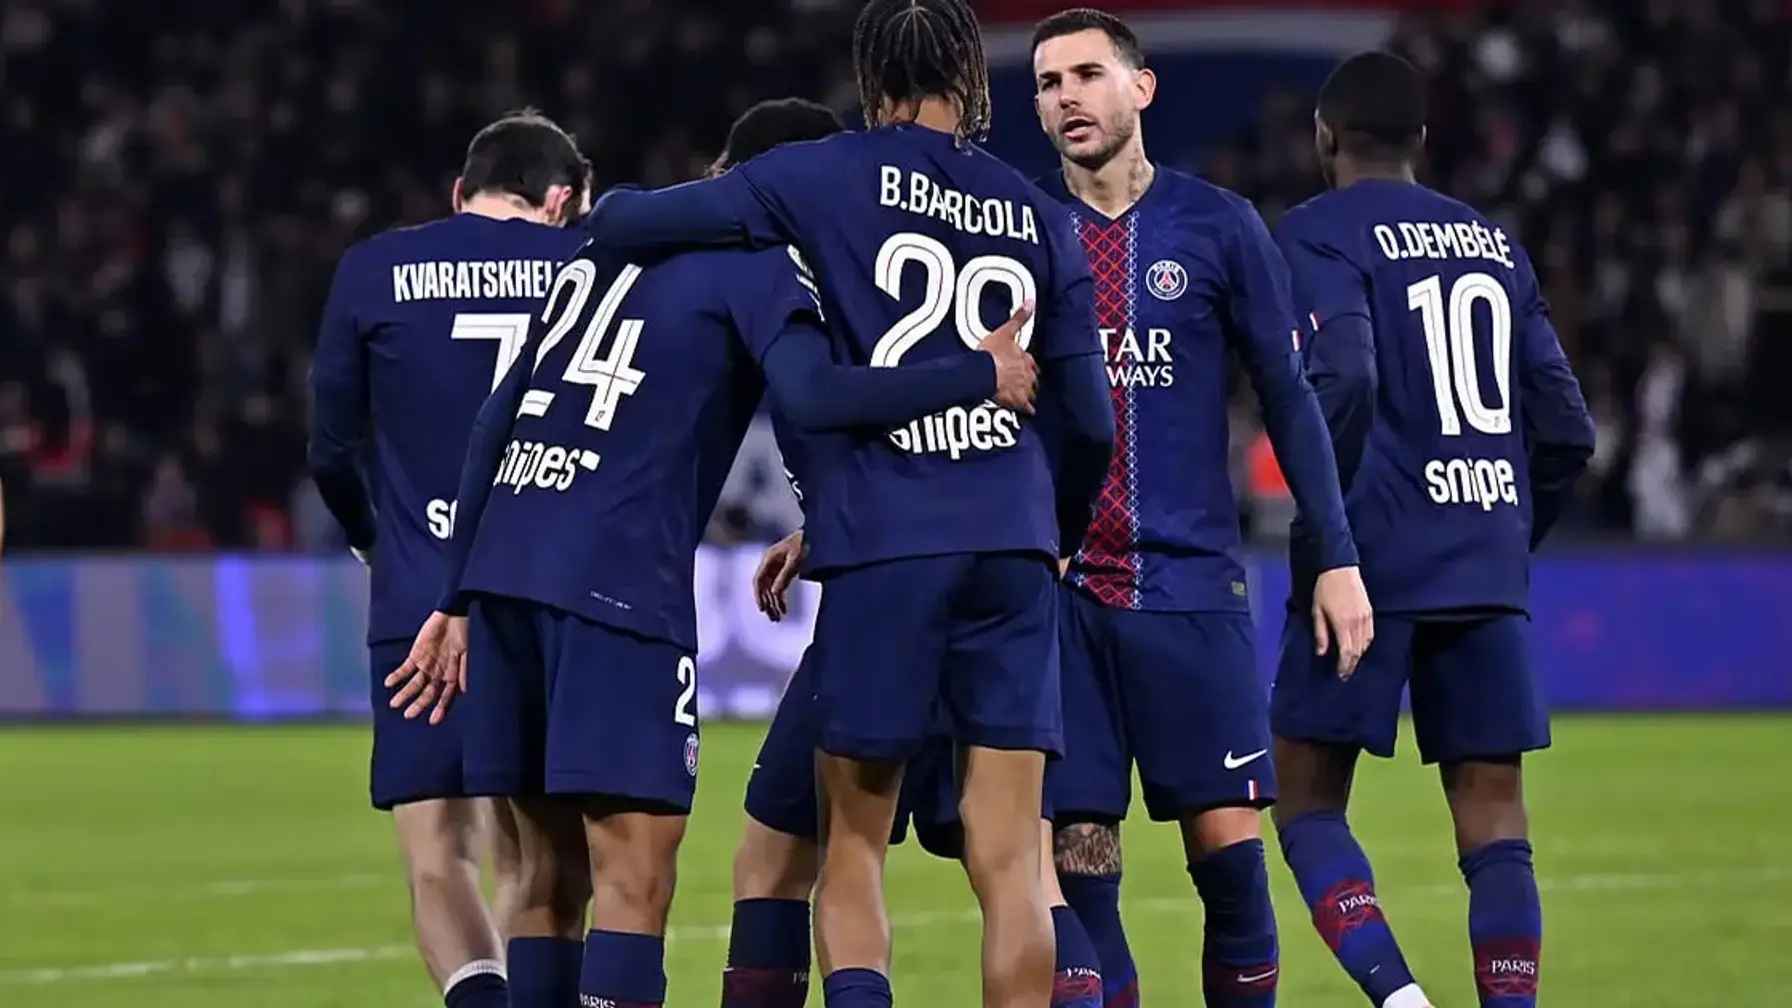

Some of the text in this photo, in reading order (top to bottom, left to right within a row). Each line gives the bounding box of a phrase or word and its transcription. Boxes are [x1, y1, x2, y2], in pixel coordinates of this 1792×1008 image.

[880, 165, 1039, 244] B.BARCOLA
[451, 313, 531, 395] 7
[516, 258, 647, 432] 24
[1407, 272, 1512, 436] 10
[494, 440, 581, 495] nipes
[1425, 458, 1518, 511] snipe
[675, 656, 696, 727] 2
[1492, 959, 1536, 975] PARIS
